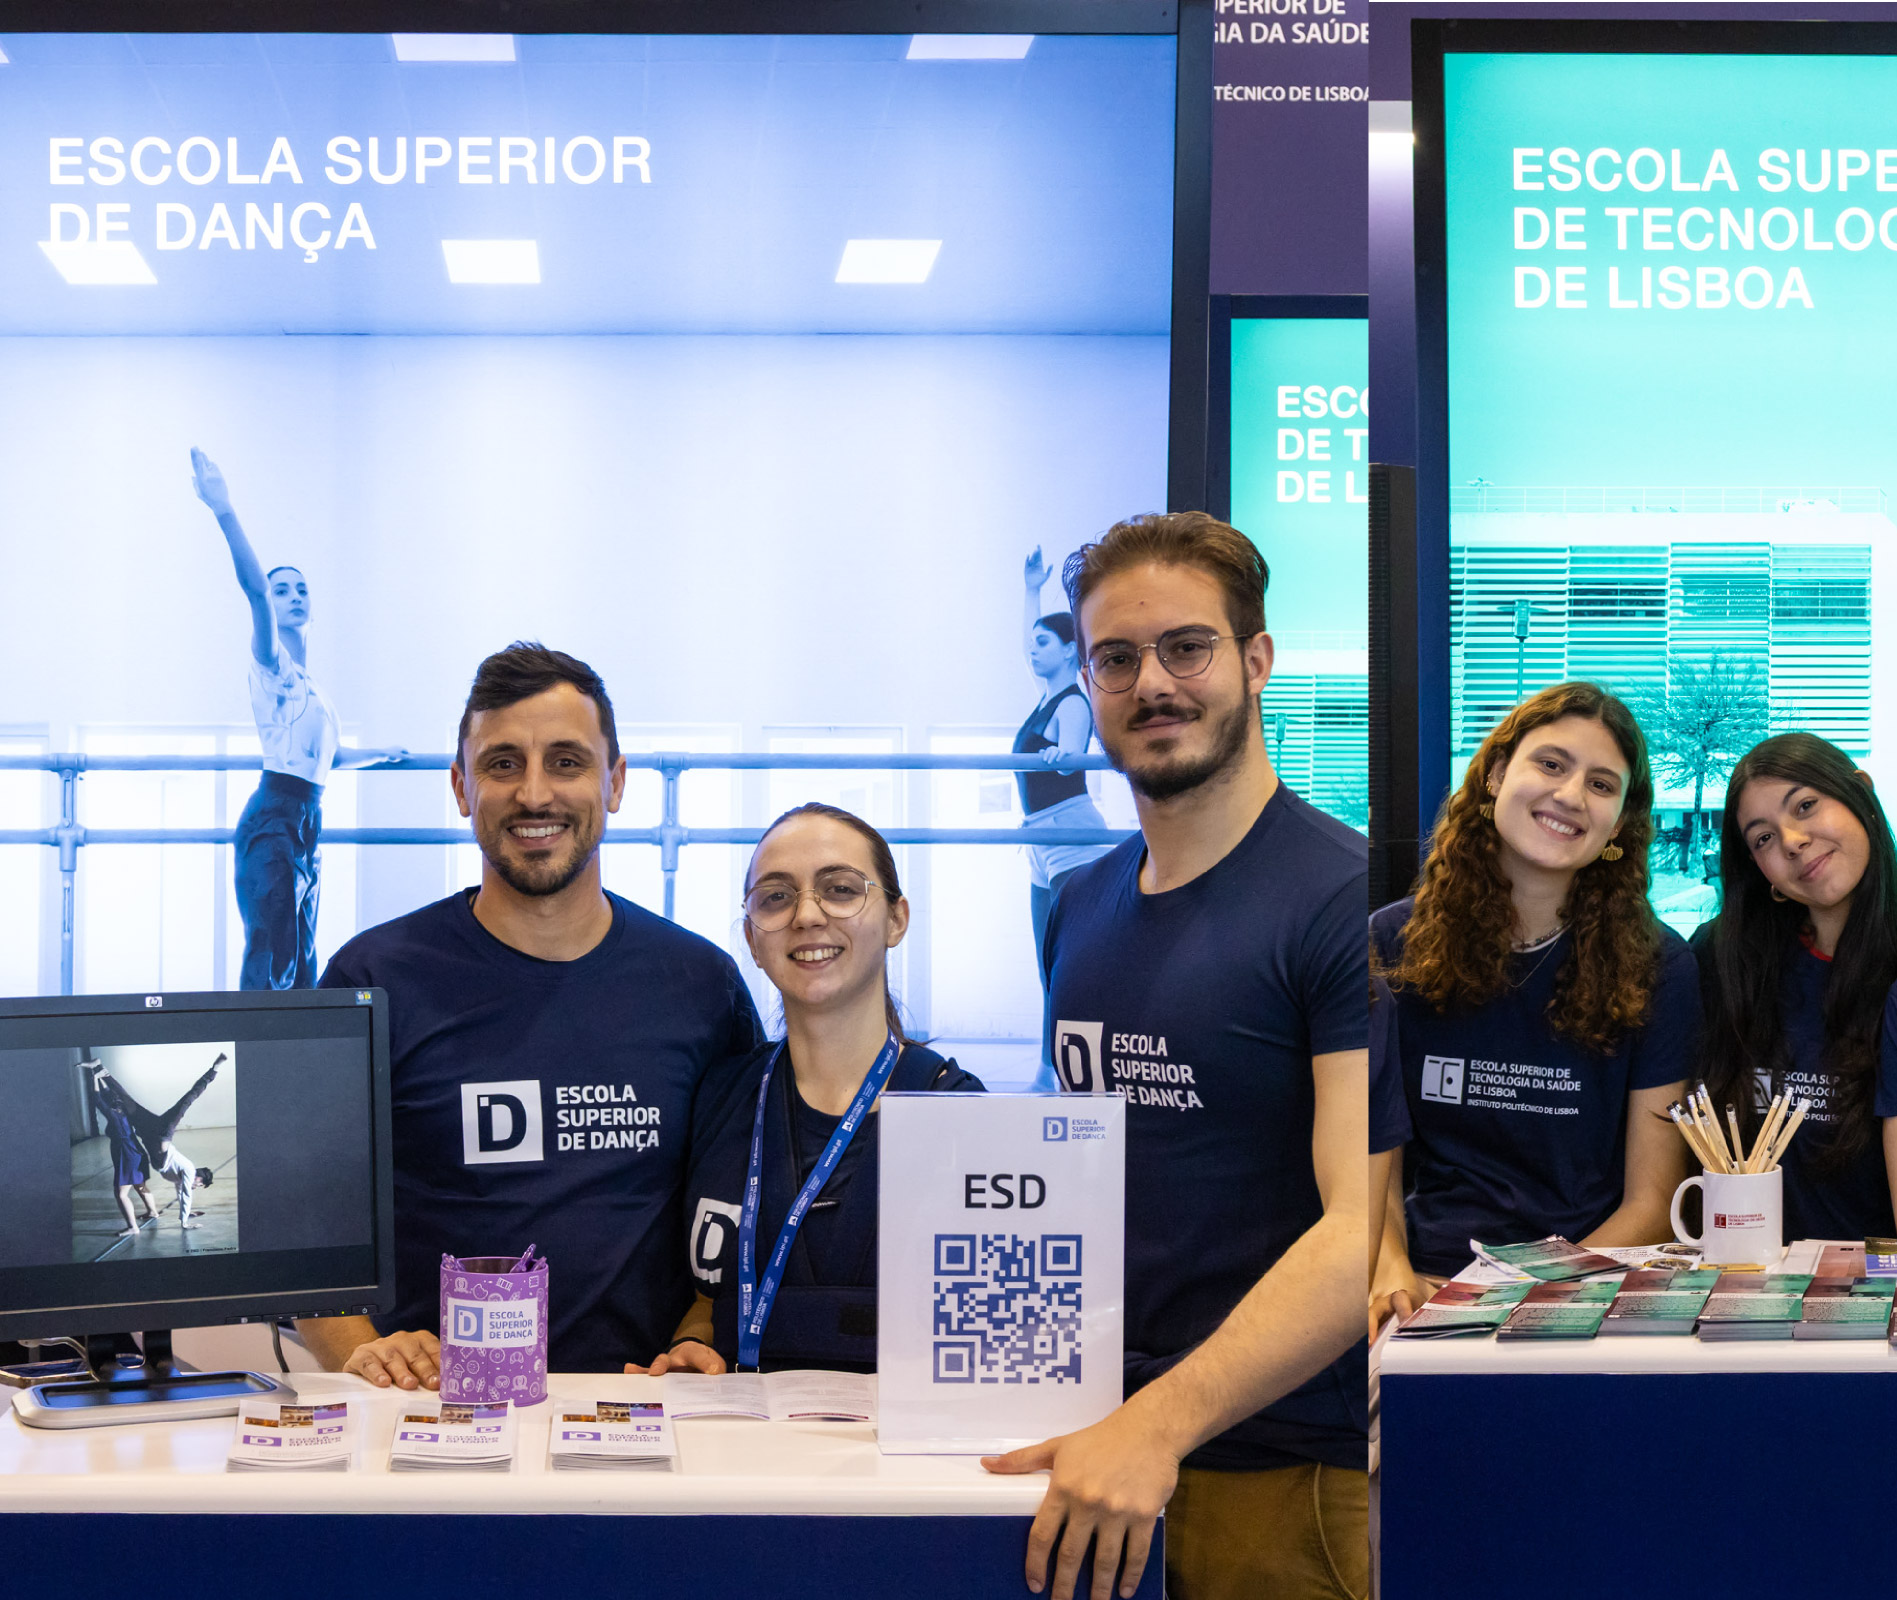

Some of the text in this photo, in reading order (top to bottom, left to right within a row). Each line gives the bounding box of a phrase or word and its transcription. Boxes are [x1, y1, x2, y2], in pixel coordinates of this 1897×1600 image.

[1215, 0, 1308, 14] PERIOR
[1251, 22, 1286, 43] DA
[1214, 83, 1311, 101] TÉCNICO DE
[48, 136, 653, 186] ESCOLA SUPERIOR
[1511, 148, 1739, 192] ESCOLA
[50, 201, 377, 265] DE DANÇA
[1513, 207, 1588, 251] DE
[1513, 265, 1814, 310] DE LISBOA
[1277, 428, 1331, 460] DE
[1276, 470, 1331, 502] DE
[1112, 1033, 1168, 1056] ESCOLA
[1112, 1059, 1195, 1084] SUPERIOR
[1470, 1060, 1571, 1078] ESCOLA SUPERIOR DE
[1468, 1085, 1517, 1098] DE LISBOA
[1469, 1072, 1581, 1091] TECNOLOGIA DA SAÚDE
[556, 1085, 637, 1104] ESCOLA
[1138, 1086, 1204, 1111] DANÇA
[557, 1107, 660, 1127] SUPERIOR
[558, 1130, 659, 1152] DE DANÇA
[964, 1173, 1046, 1210] ESD
[489, 1311, 523, 1319] ESCOLA
